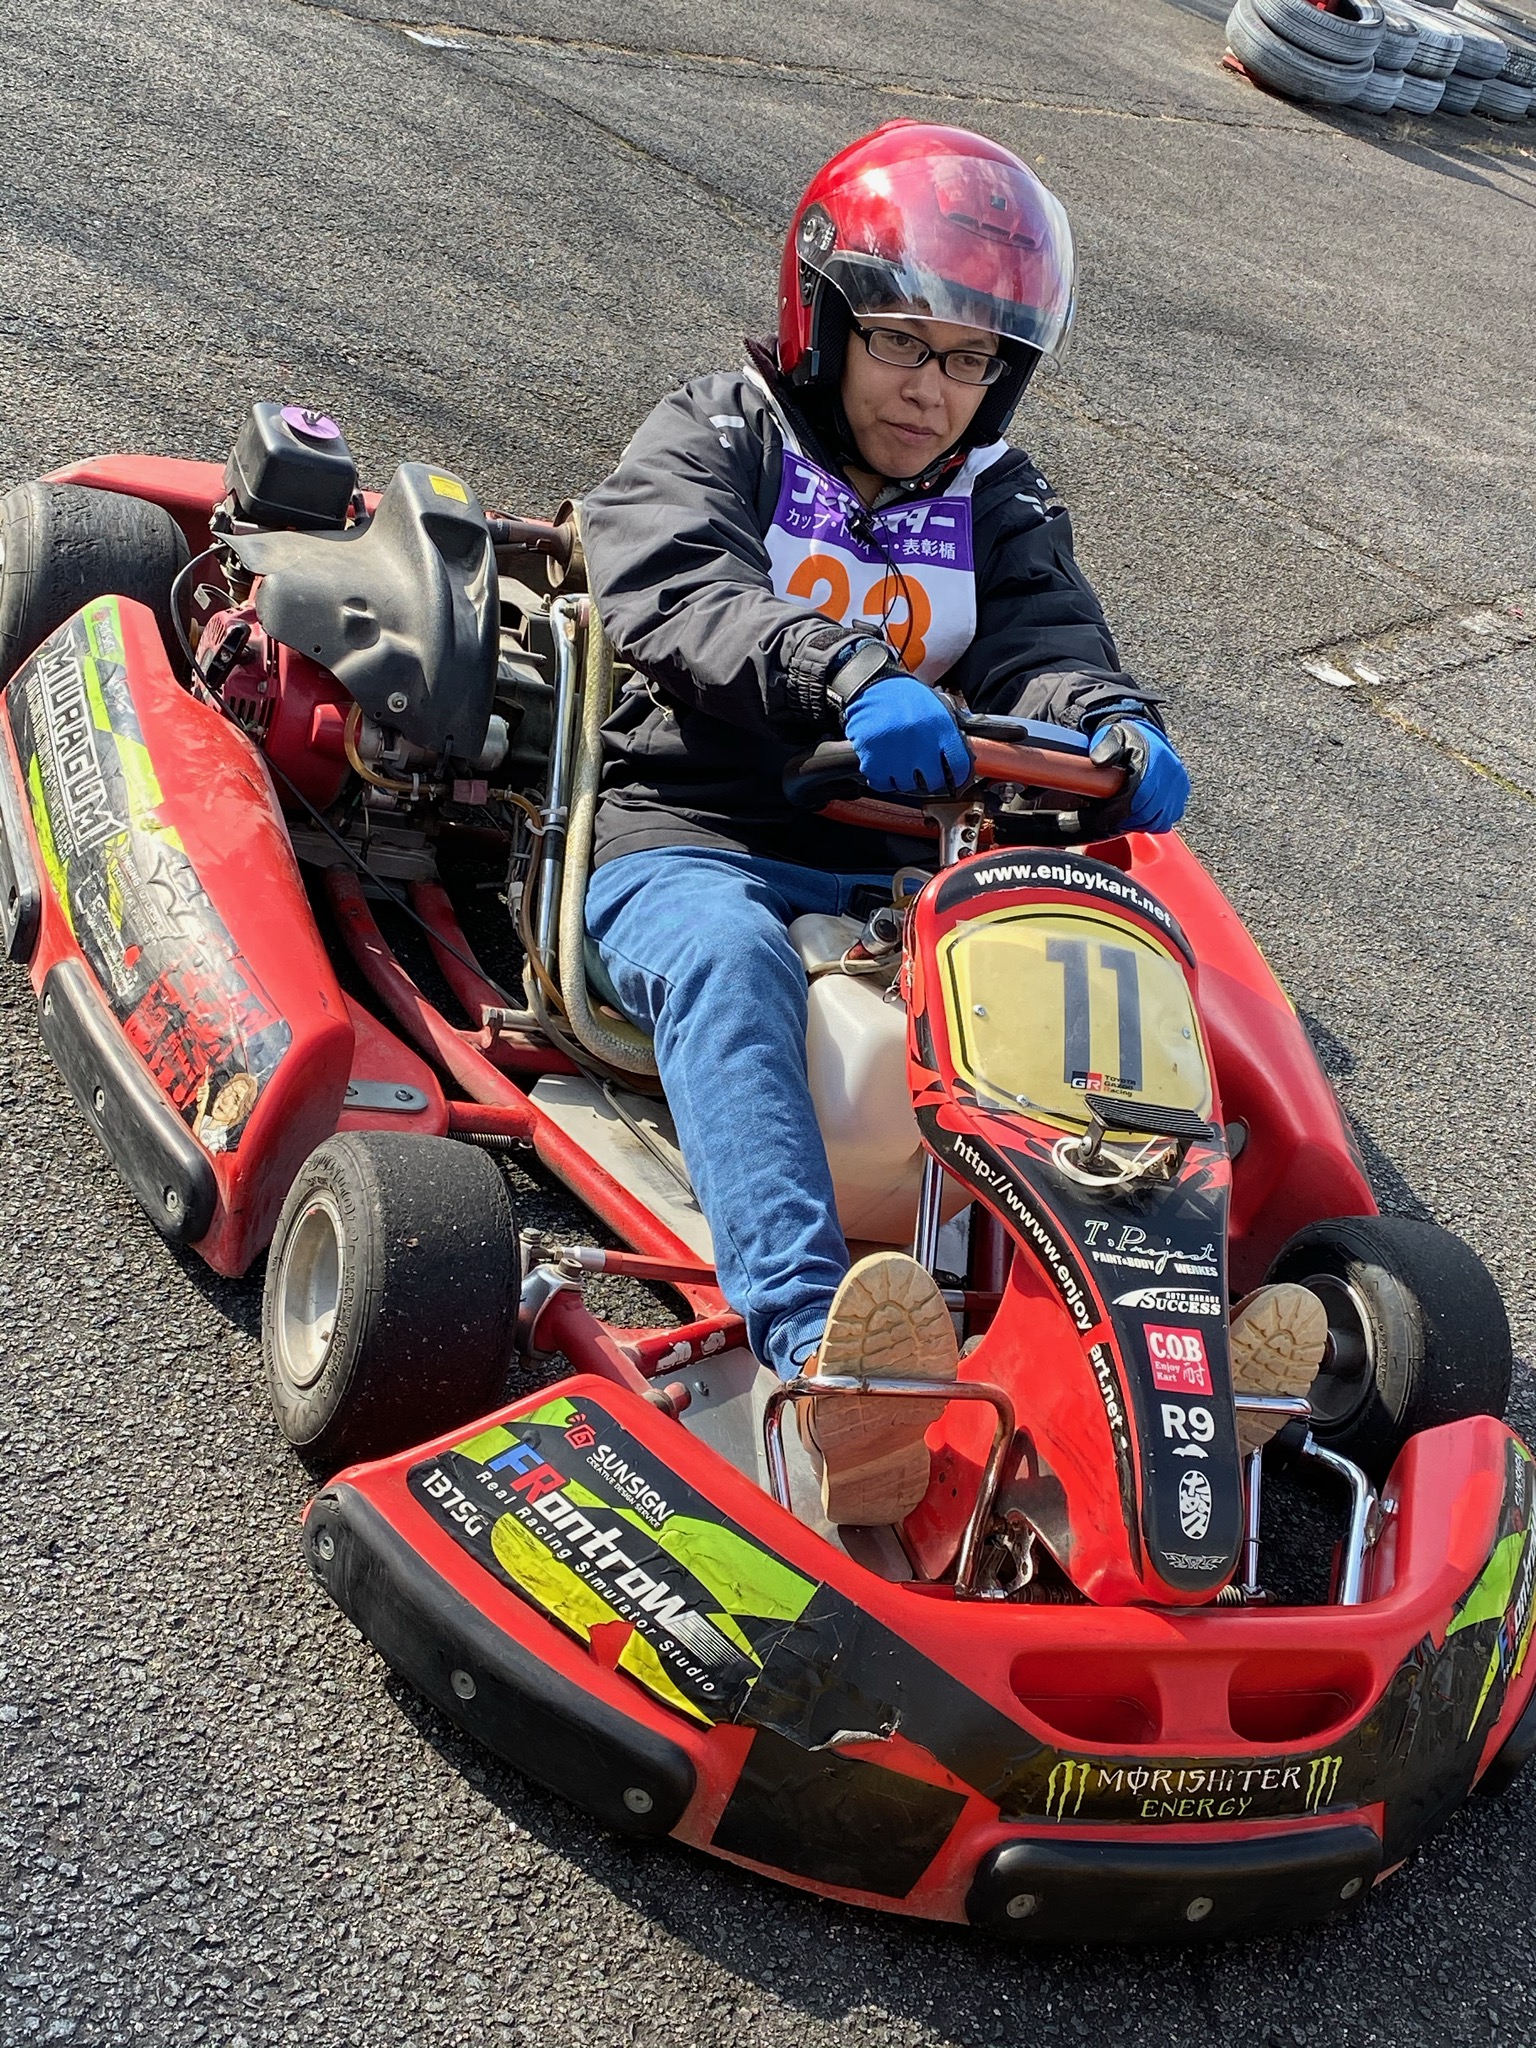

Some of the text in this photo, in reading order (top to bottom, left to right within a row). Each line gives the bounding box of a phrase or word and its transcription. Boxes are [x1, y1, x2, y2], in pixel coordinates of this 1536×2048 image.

[974, 864, 1172, 929] www.enjoykart.net
[1045, 939, 1143, 1092] 11
[1071, 1077, 1101, 1091] GR
[1103, 1080, 1133, 1091] GAZOO
[1104, 1074, 1136, 1086] TOYOTA
[1103, 1086, 1132, 1098] Racing
[1173, 1262, 1219, 1277] WERKES
[1139, 1291, 1221, 1316] SUCCESS
[1165, 1291, 1220, 1303] AUTO GARAGE
[1154, 1360, 1181, 1374] Enjoy
[1156, 1371, 1178, 1382] Kart
[1160, 1403, 1215, 1442] R9
[585, 1456, 661, 1528] CREATIVE DESIGN SERVICE
[592, 1444, 675, 1522] SUNSIGN
[475, 1470, 716, 1692] Real Racing Simulator Studio
[1140, 1796, 1253, 1818] ENERGY
